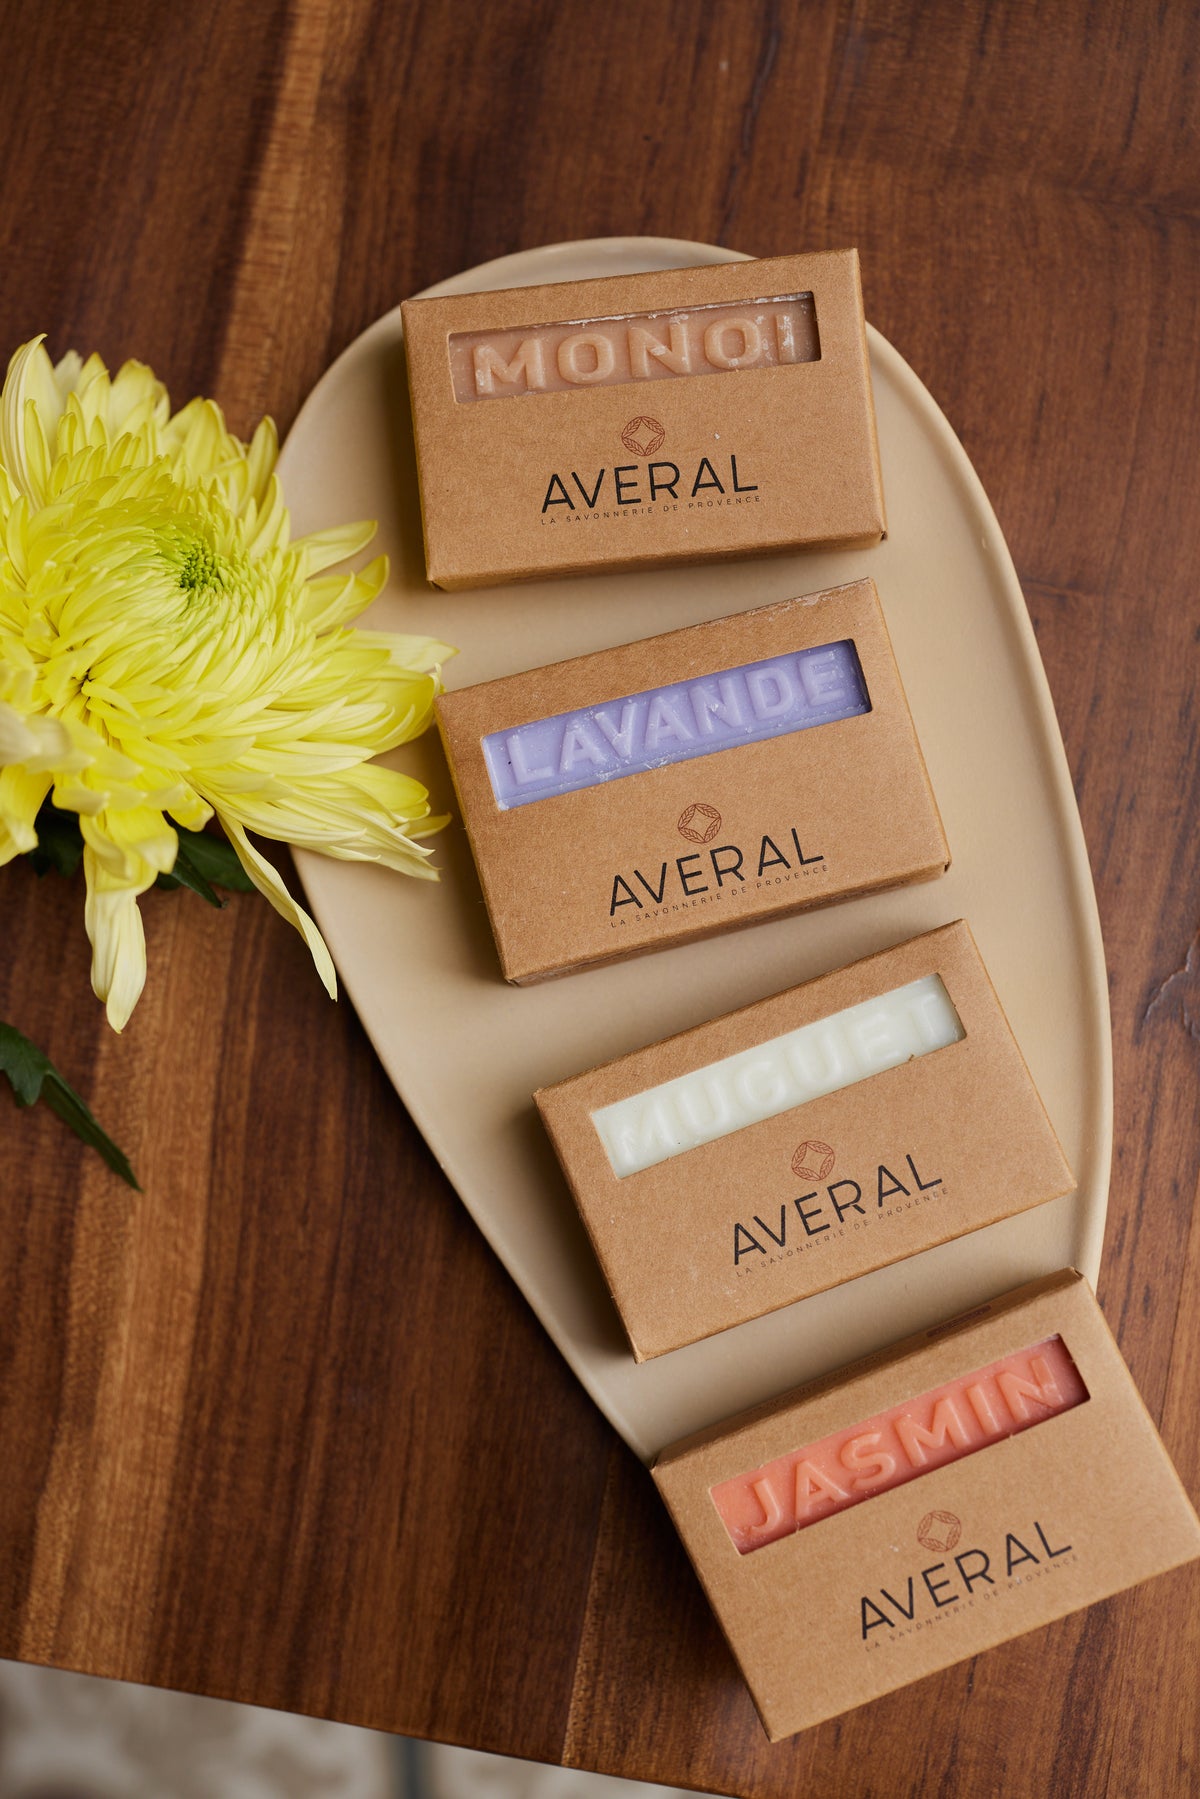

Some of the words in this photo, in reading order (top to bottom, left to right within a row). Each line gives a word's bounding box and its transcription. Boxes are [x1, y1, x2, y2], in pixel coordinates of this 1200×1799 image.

[472, 312, 797, 396] MONOI
[541, 454, 759, 514] AVERAL
[541, 518, 556, 526] LA
[566, 506, 653, 523] SAVONNERIE
[663, 504, 679, 513] DE
[688, 495, 761, 509] PROVENCE
[506, 650, 846, 785] LAVANDE
[609, 827, 824, 917] AVERAL
[611, 919, 626, 928] LA
[635, 893, 722, 922] SAVONNERIE
[731, 887, 747, 896] DE
[756, 864, 829, 889] PROVENCE
[734, 1153, 943, 1266] AVERAL
[736, 1267, 753, 1278] LA
[760, 1229, 845, 1268] SAVONNERIE
[854, 1219, 870, 1230] DE
[746, 1353, 1065, 1536] JASMIN
[861, 1521, 1073, 1640] AVERAL
[983, 1589, 999, 1600] DE
